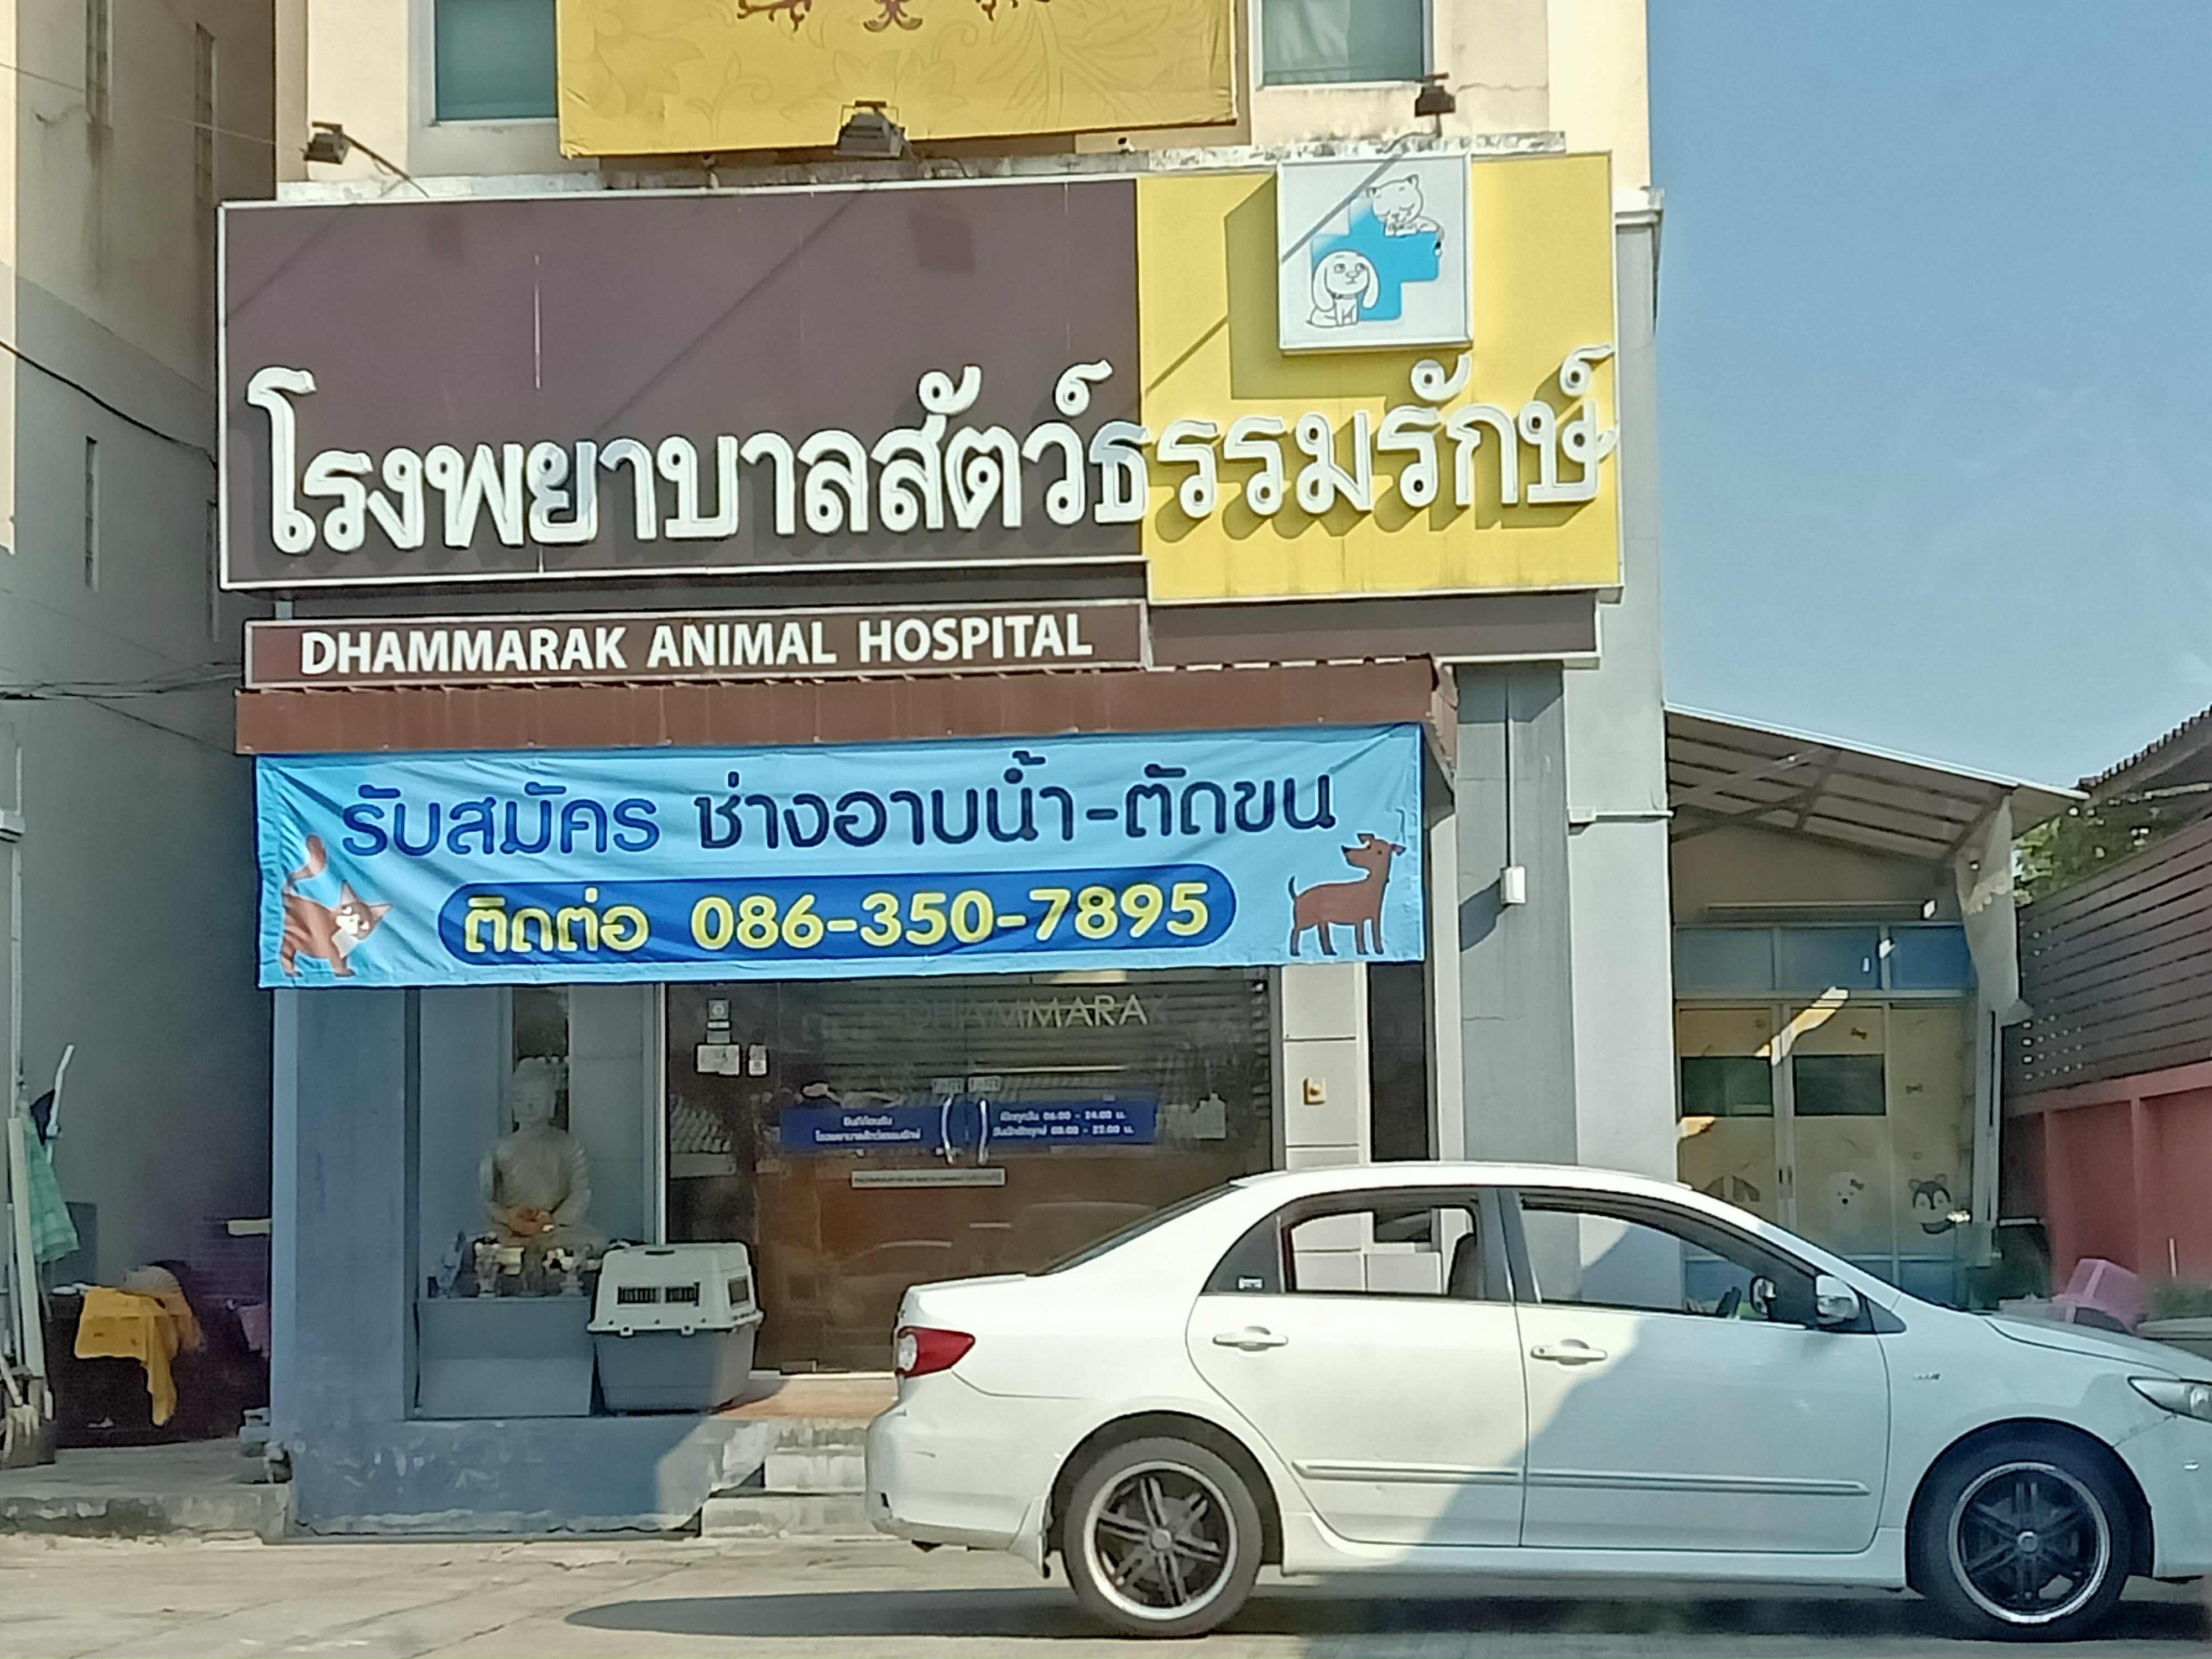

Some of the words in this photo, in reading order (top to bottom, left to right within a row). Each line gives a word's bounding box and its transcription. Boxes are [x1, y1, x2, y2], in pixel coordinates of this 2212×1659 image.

[248, 343, 1618, 554] โรงพยาบาลสัตว์ธรรมรักษ์
[301, 627, 628, 674] DHAMMARAK
[646, 620, 837, 668] ANIMAL
[859, 613, 1093, 663] HOSPITAL
[342, 781, 660, 856] รับสมัคร
[692, 750, 1337, 849] ช่างอาบน้ำ-ตัดขน
[464, 886, 649, 954] ติดต่อ
[691, 881, 1210, 951] 086-350-7895
